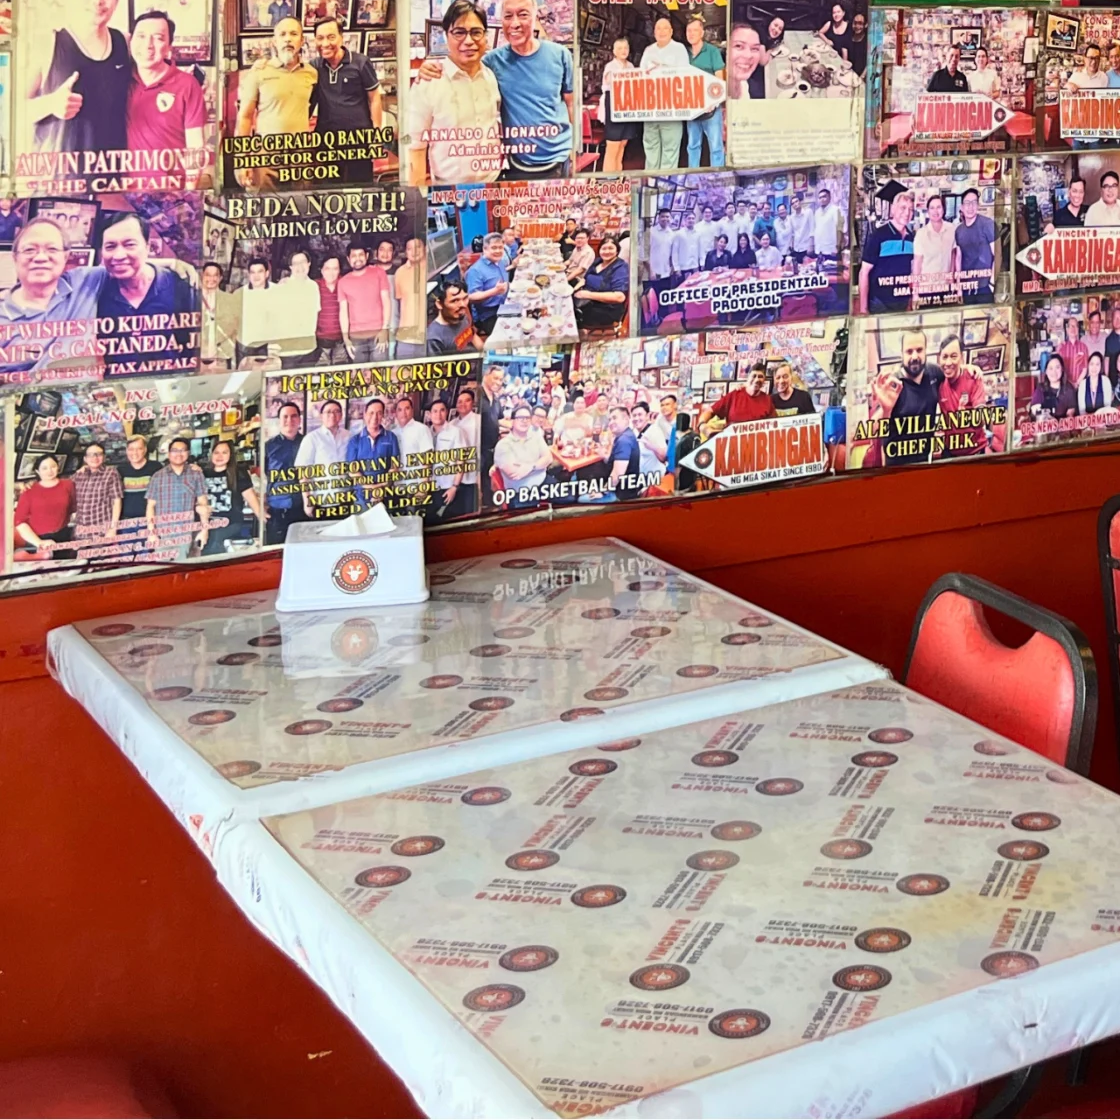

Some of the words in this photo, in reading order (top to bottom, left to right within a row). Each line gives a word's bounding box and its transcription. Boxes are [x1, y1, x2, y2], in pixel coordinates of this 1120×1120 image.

[613, 76, 705, 111] KAMBINGAN
[224, 135, 262, 155] USEC
[263, 133, 322, 152] GERALD
[324, 133, 336, 150] Q
[338, 127, 393, 147] BANTAG
[421, 128, 483, 142] ARNALDO
[505, 125, 559, 139] IGNACIO
[233, 151, 313, 170] DIRECTOR
[315, 147, 388, 163] GENERAL
[448, 142, 537, 157] Administrator
[15, 151, 79, 176] ALVIN
[278, 165, 340, 183] BUCOR
[471, 156, 511, 172] OWWA
[227, 195, 298, 219] BEDA
[306, 191, 406, 215] NORTH!
[235, 221, 320, 241] KAMBING
[325, 216, 398, 235] LOVERS!
[658, 286, 709, 305] OFFICE
[712, 286, 731, 299] OF
[731, 276, 828, 298] PRESIDENTIAL
[712, 294, 782, 314] PROTOCOL
[93, 317, 115, 334] TO
[118, 311, 201, 331] KUMPARE
[110, 362, 136, 375] TAX
[138, 357, 197, 371] APPEALS
[281, 371, 366, 393] IGLESIA
[371, 367, 392, 385] NI
[396, 360, 471, 382] CRISTO
[404, 379, 449, 391] PACO
[853, 416, 891, 440] ALE
[893, 407, 1006, 438] VILLANEUVE
[715, 425, 822, 478] KAMBINGAN
[270, 464, 325, 482] PASTOR
[406, 447, 477, 467] ENRIQUEZ
[492, 489, 516, 506] OP
[518, 477, 617, 504] BASKETBALL
[619, 472, 661, 490] TEAM
